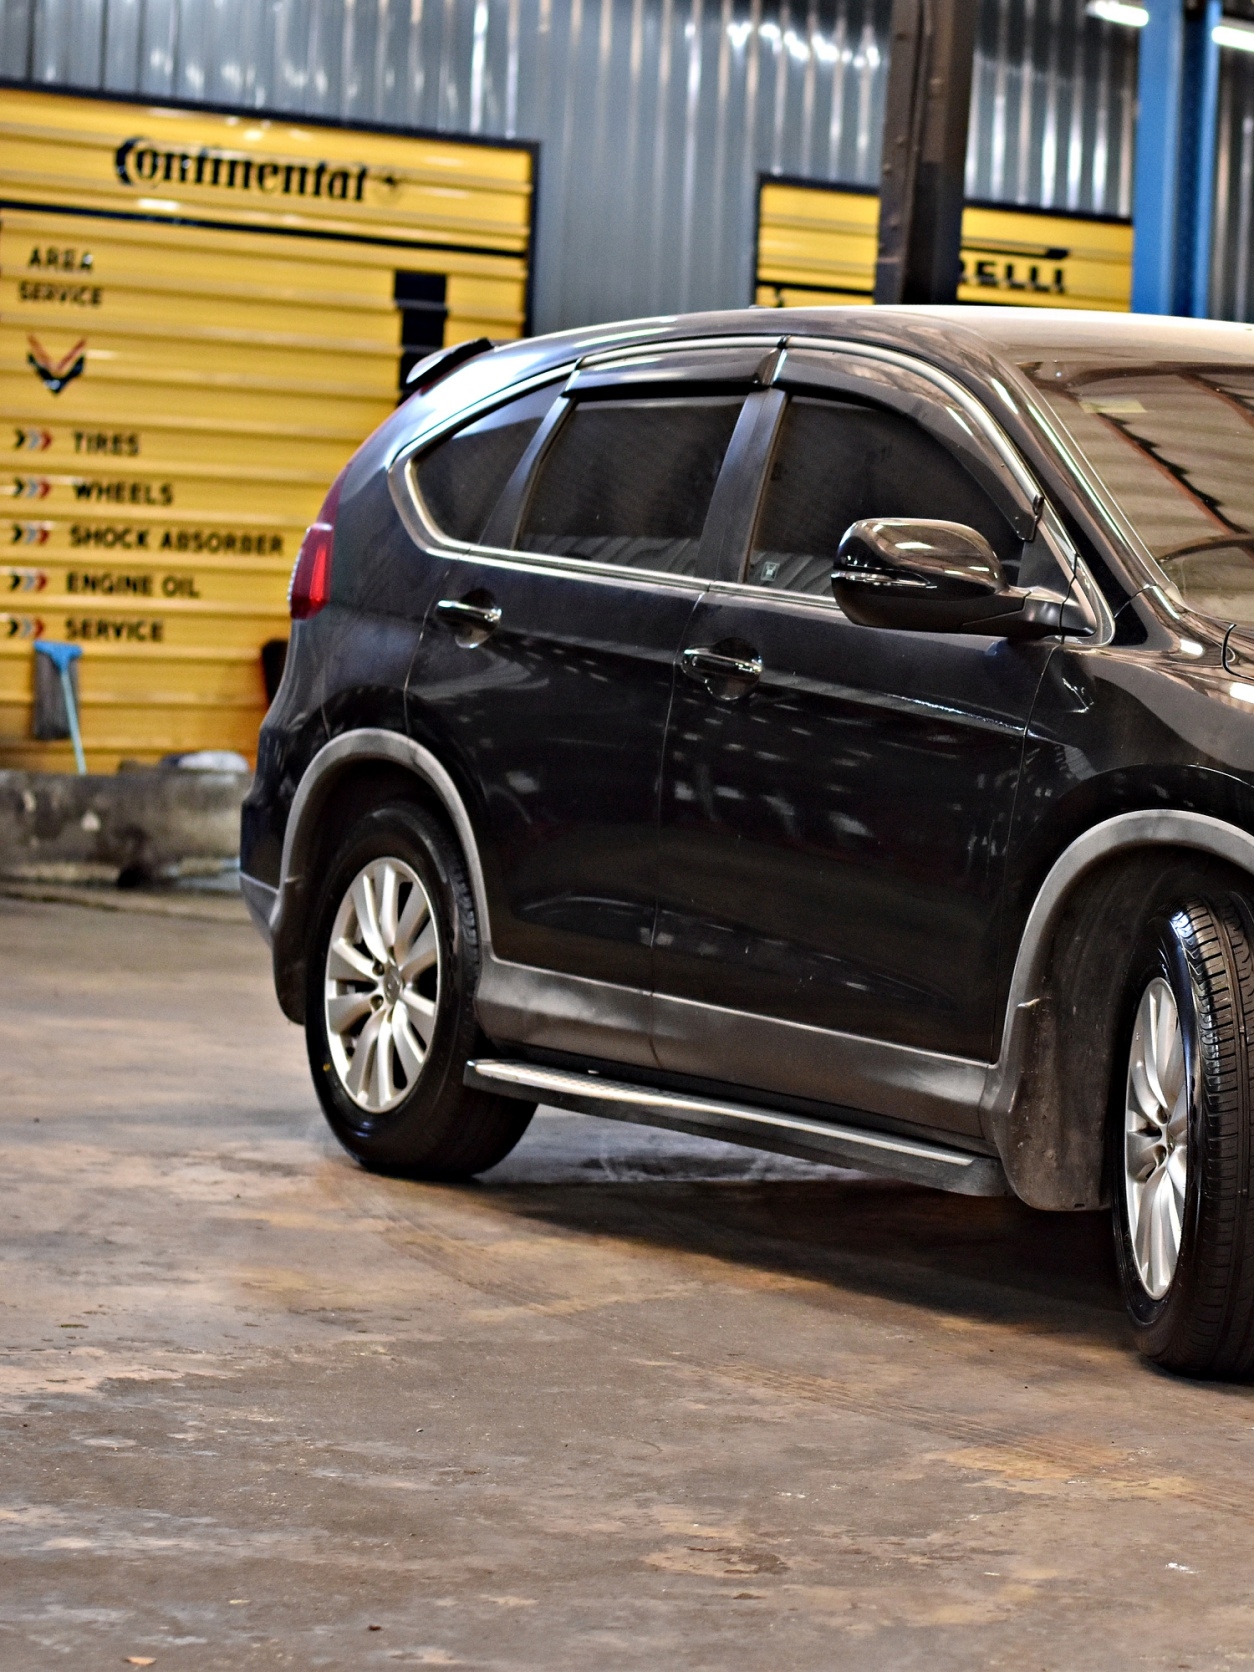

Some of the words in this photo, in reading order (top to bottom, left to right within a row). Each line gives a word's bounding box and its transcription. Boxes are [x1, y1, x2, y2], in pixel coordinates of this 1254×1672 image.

[114, 136, 370, 202] Continental
[28, 246, 95, 275] AREA
[18, 281, 104, 307] SERVICE
[72, 431, 140, 456] TIRES
[73, 482, 173, 506] WHEELS
[70, 527, 149, 551] SHOCK
[160, 530, 285, 556] ABSORBER
[66, 572, 154, 596] ENGINE
[162, 576, 200, 598] OIL
[65, 619, 163, 642] SERVICE
